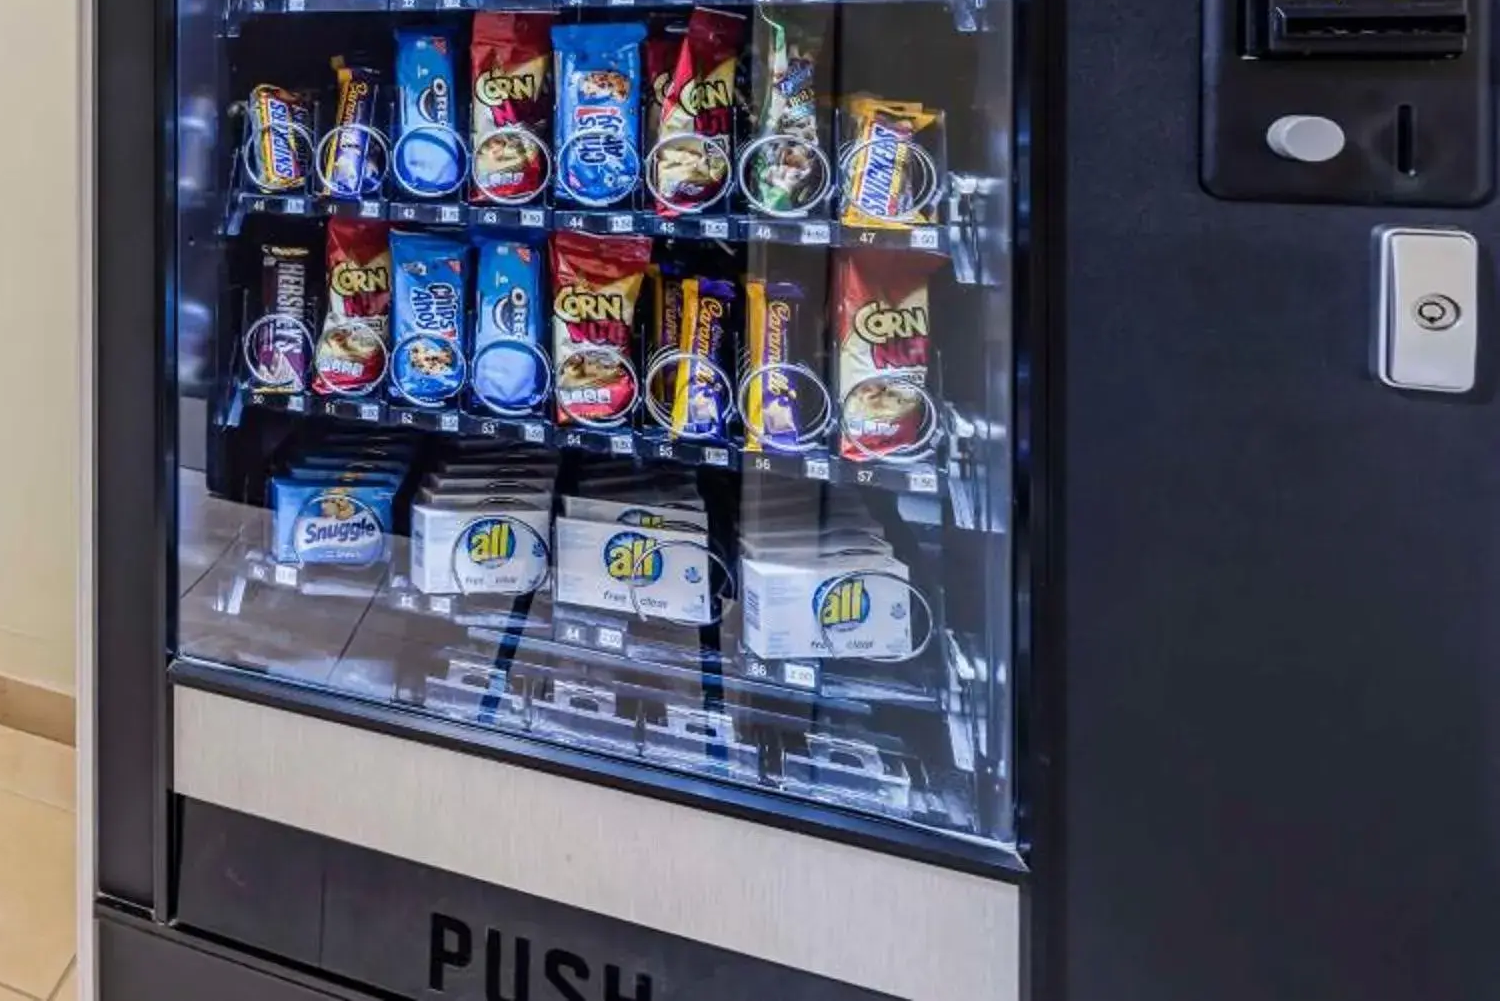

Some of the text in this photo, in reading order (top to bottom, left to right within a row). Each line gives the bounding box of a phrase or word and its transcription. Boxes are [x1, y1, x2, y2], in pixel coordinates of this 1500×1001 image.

[476, 67, 534, 106] CORN
[860, 125, 898, 216] SNICKERS
[569, 216, 583, 228] 44
[660, 222, 674, 234] 45
[859, 232, 876, 244] 47
[331, 260, 388, 296] CORN
[554, 285, 622, 323] CORN
[855, 302, 928, 344] CORN
[696, 297, 723, 385] Caramllo
[768, 301, 791, 395] Caramllo
[755, 458, 771, 470] 56
[857, 470, 873, 482] 57
[305, 519, 375, 544] Snuggle
[471, 524, 509, 562] all
[609, 537, 656, 577] all
[821, 579, 864, 626] all
